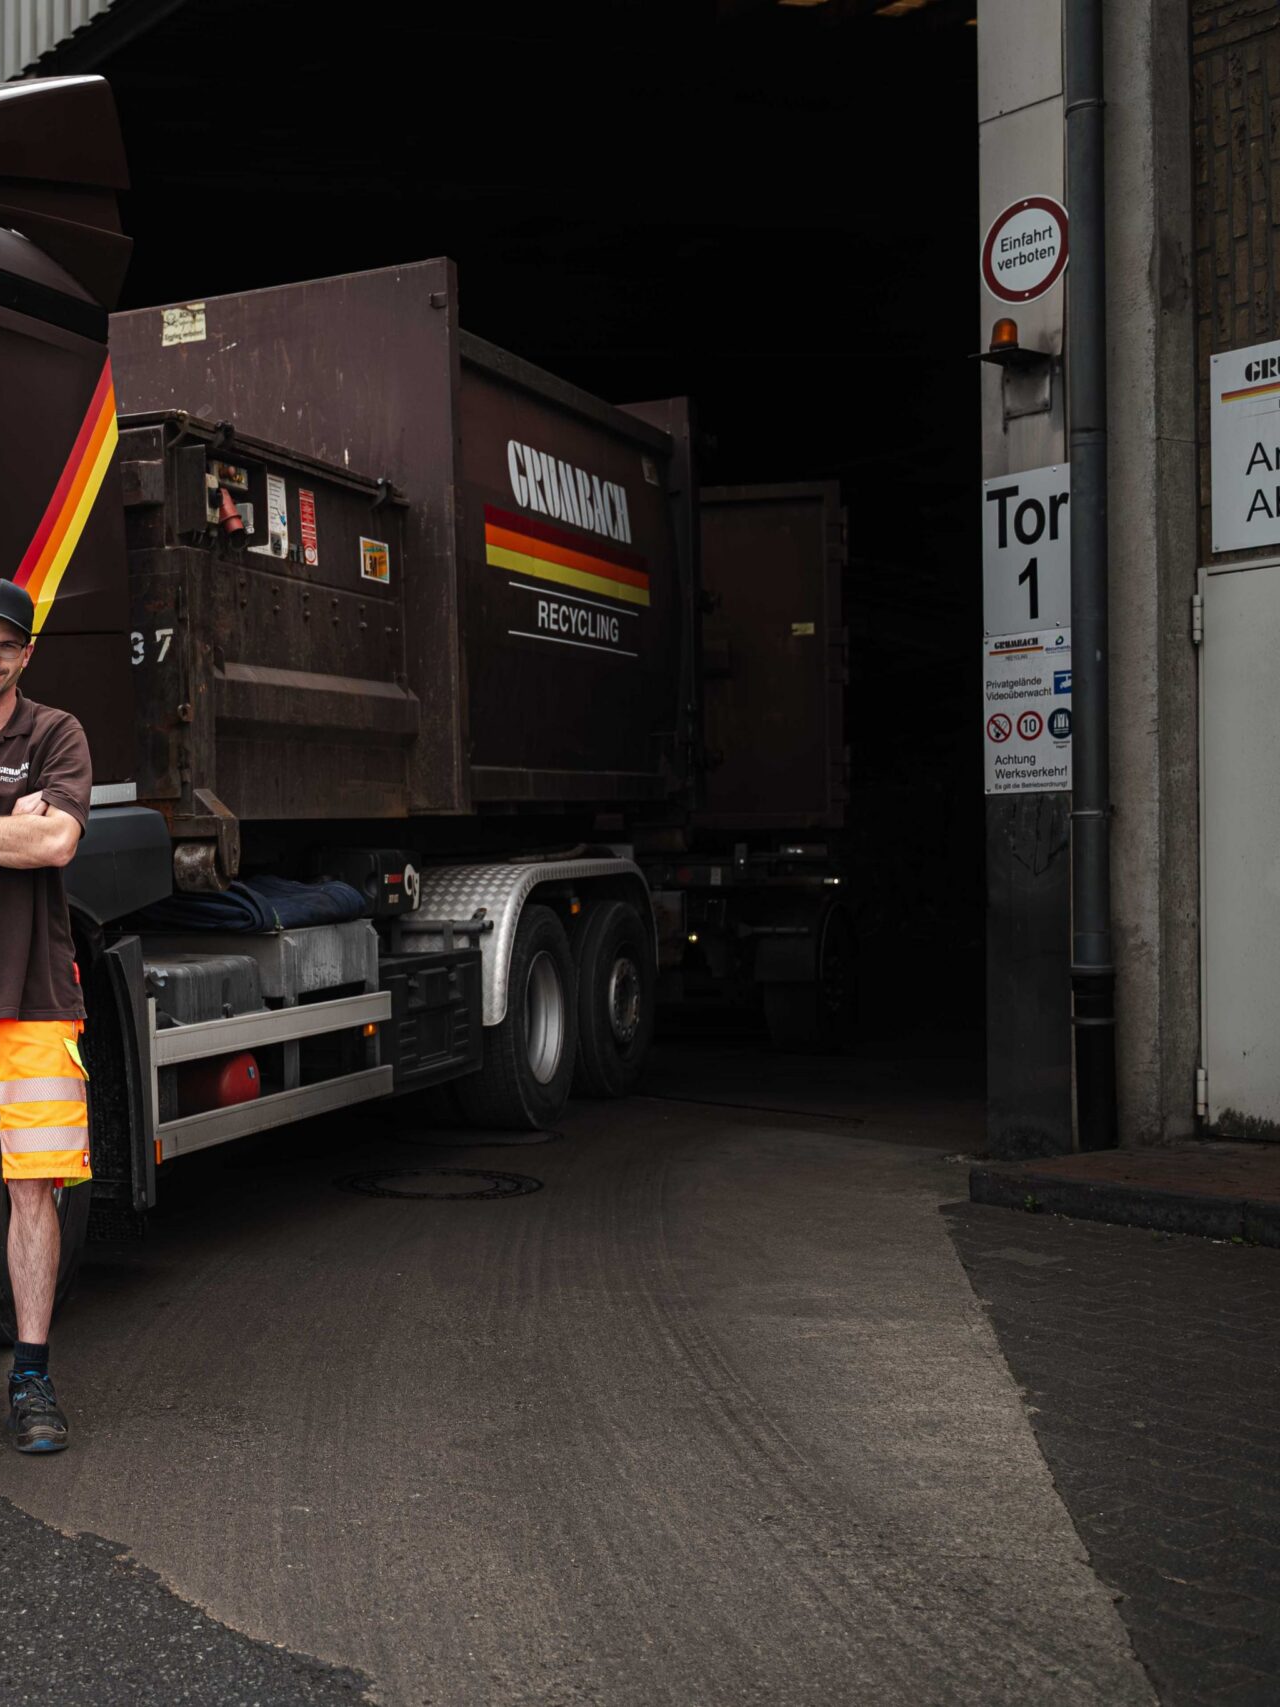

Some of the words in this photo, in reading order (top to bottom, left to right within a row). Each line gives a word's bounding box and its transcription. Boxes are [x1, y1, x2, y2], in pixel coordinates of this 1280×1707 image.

[1000, 225, 1053, 253] Einfahrt
[997, 245, 1055, 272] verboten
[1245, 356, 1280, 383] GR
[1245, 442, 1280, 475] A
[507, 440, 632, 544] GRUMBACH
[1246, 486, 1280, 522] A
[986, 485, 1069, 549] Tor
[1018, 557, 1039, 620] 1
[538, 600, 619, 643] RECYCLING
[994, 637, 1039, 649] GRUMBACH
[986, 676, 1042, 690] Privatgelände
[986, 687, 1052, 702] Videoüberwacht
[1023, 718, 1036, 733] 10
[995, 754, 1036, 767] Achtung
[995, 765, 1068, 779] Werksverkehr!
